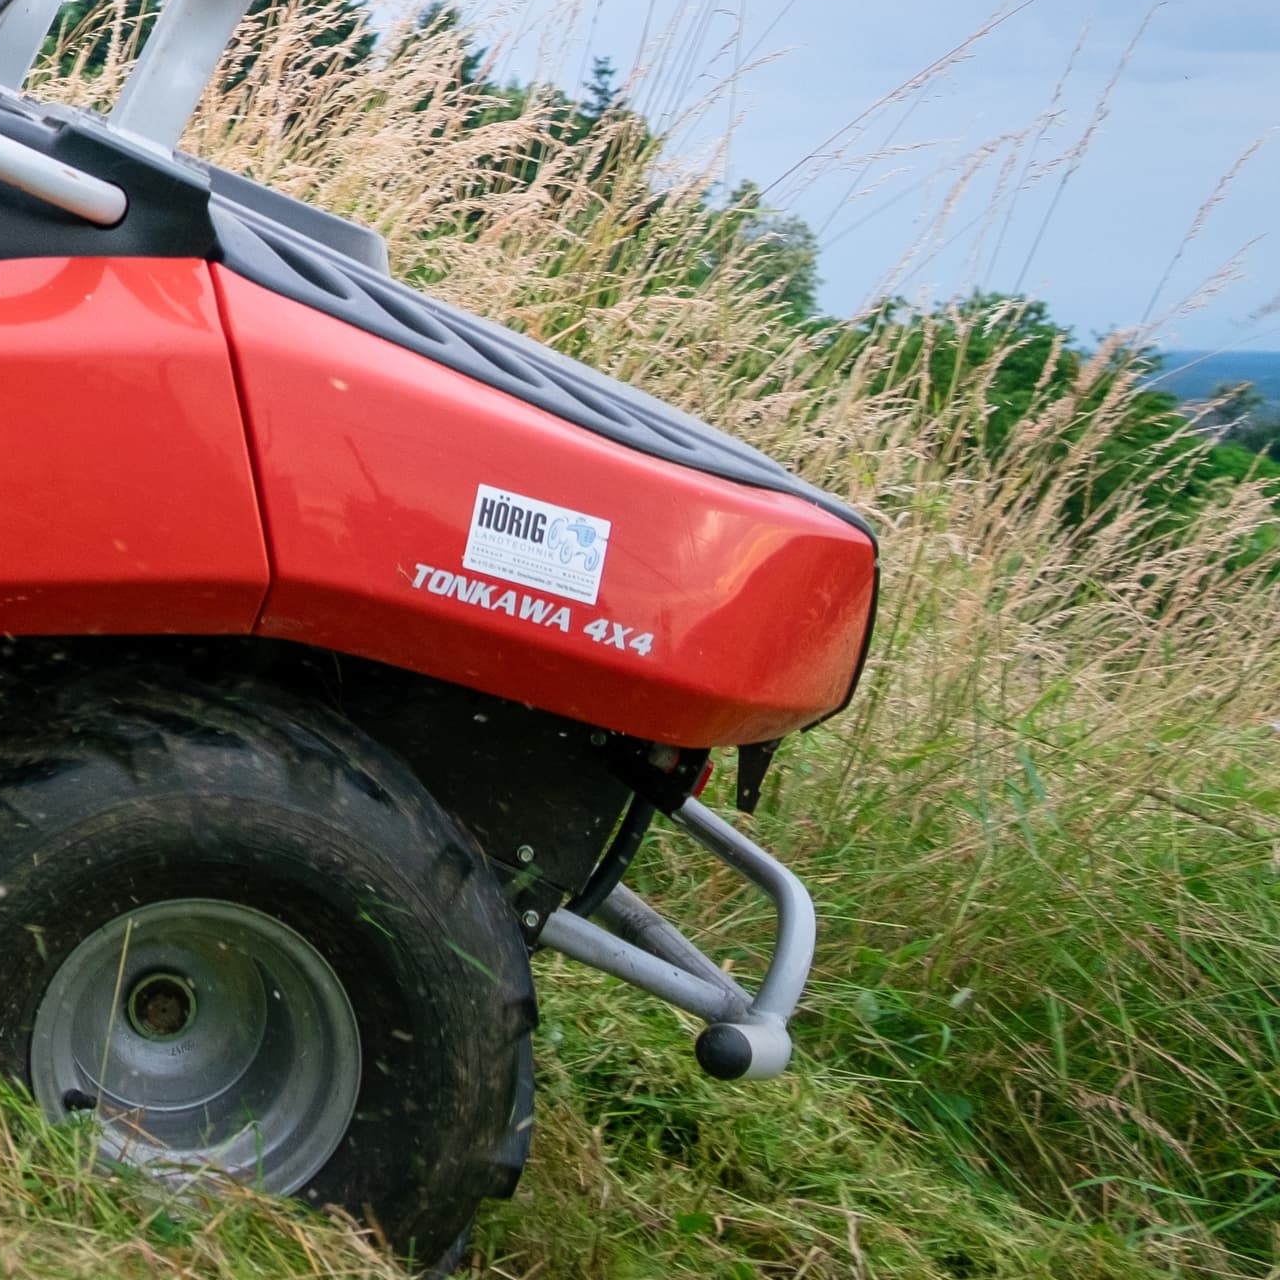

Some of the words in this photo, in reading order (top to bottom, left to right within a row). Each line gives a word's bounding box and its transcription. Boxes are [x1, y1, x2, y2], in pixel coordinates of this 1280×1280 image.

[478, 495, 547, 544] HÖRIG
[474, 531, 554, 560] LANDTECHNIK
[412, 563, 572, 632] TONKAWA
[583, 619, 654, 657] 4X4
